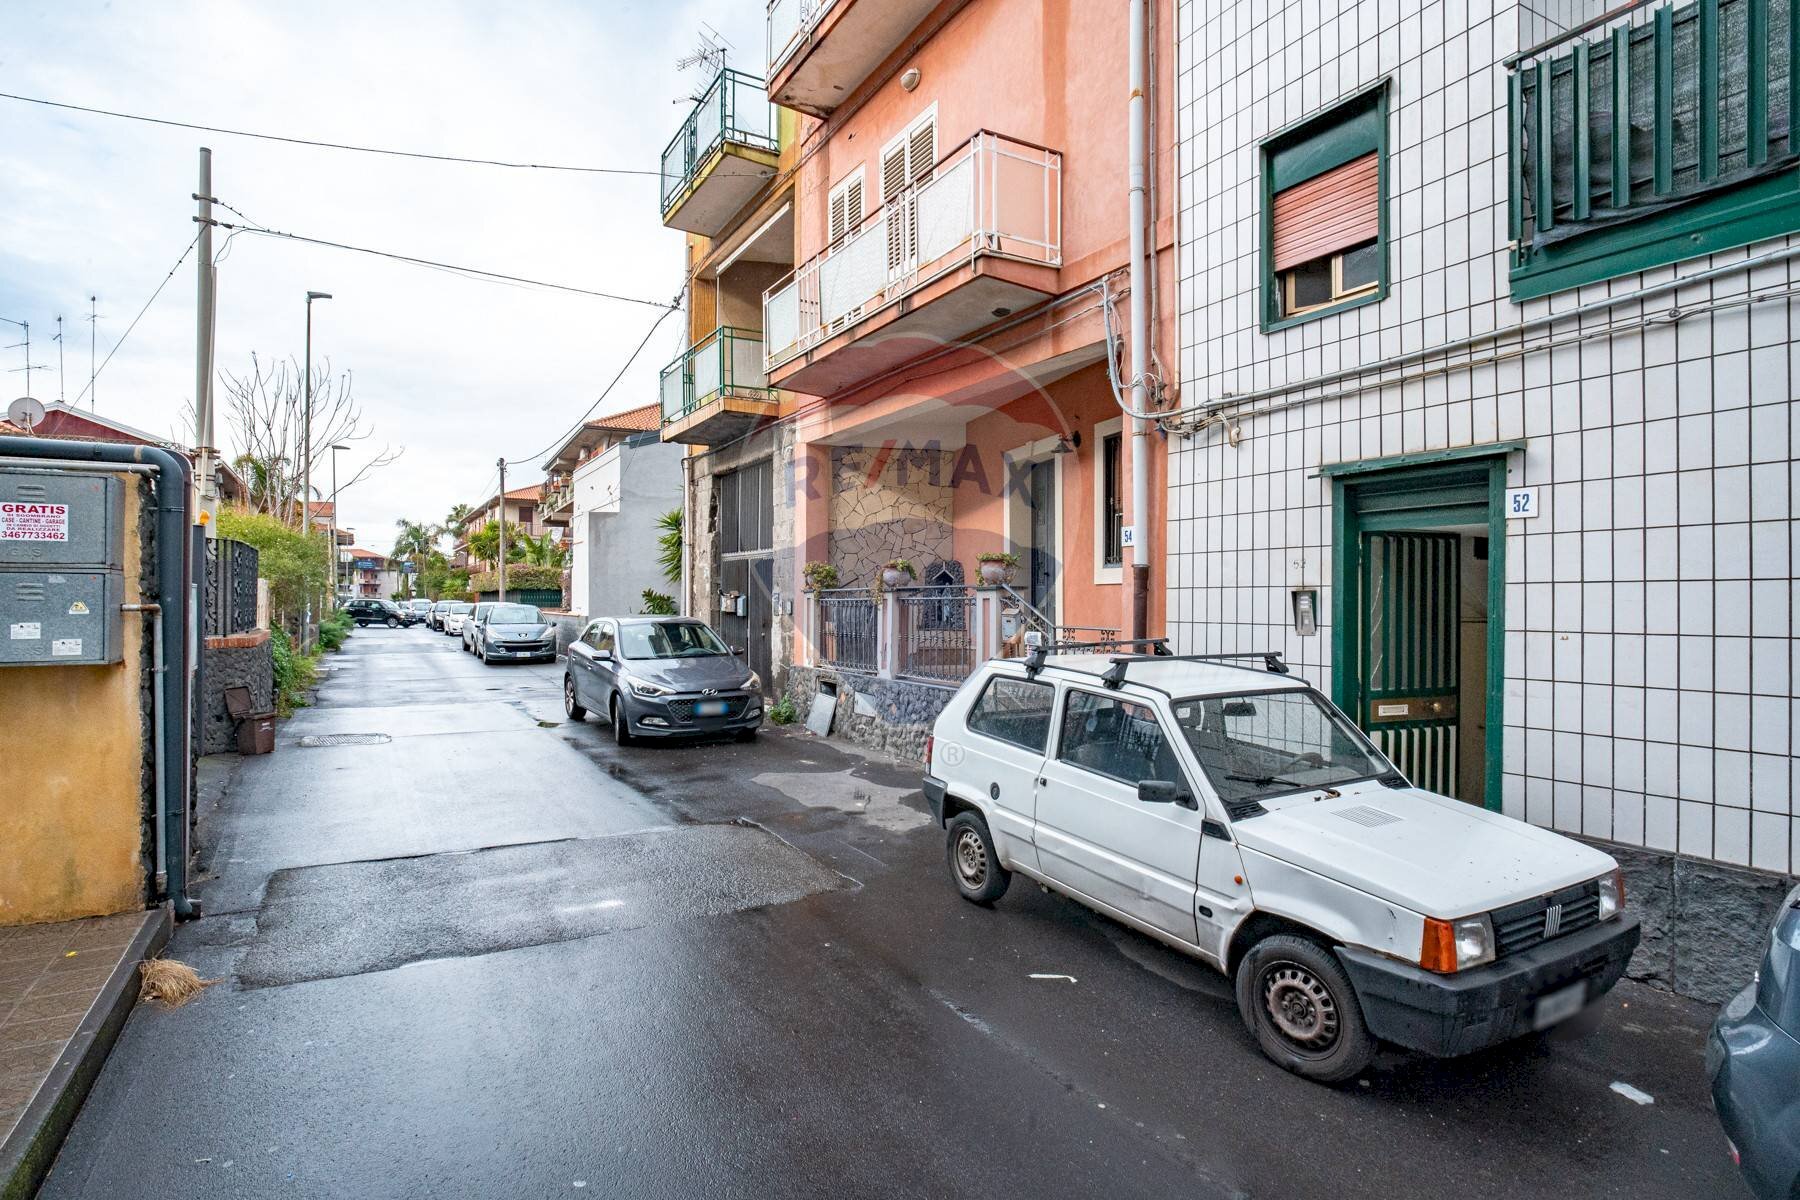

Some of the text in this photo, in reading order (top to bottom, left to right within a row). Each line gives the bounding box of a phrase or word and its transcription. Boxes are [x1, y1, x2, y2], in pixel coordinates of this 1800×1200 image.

[1513, 494, 1530, 512] 52
[2, 504, 65, 514] GRATIS
[1, 531, 65, 539] 3467733462
[1125, 530, 1132, 543] 54
